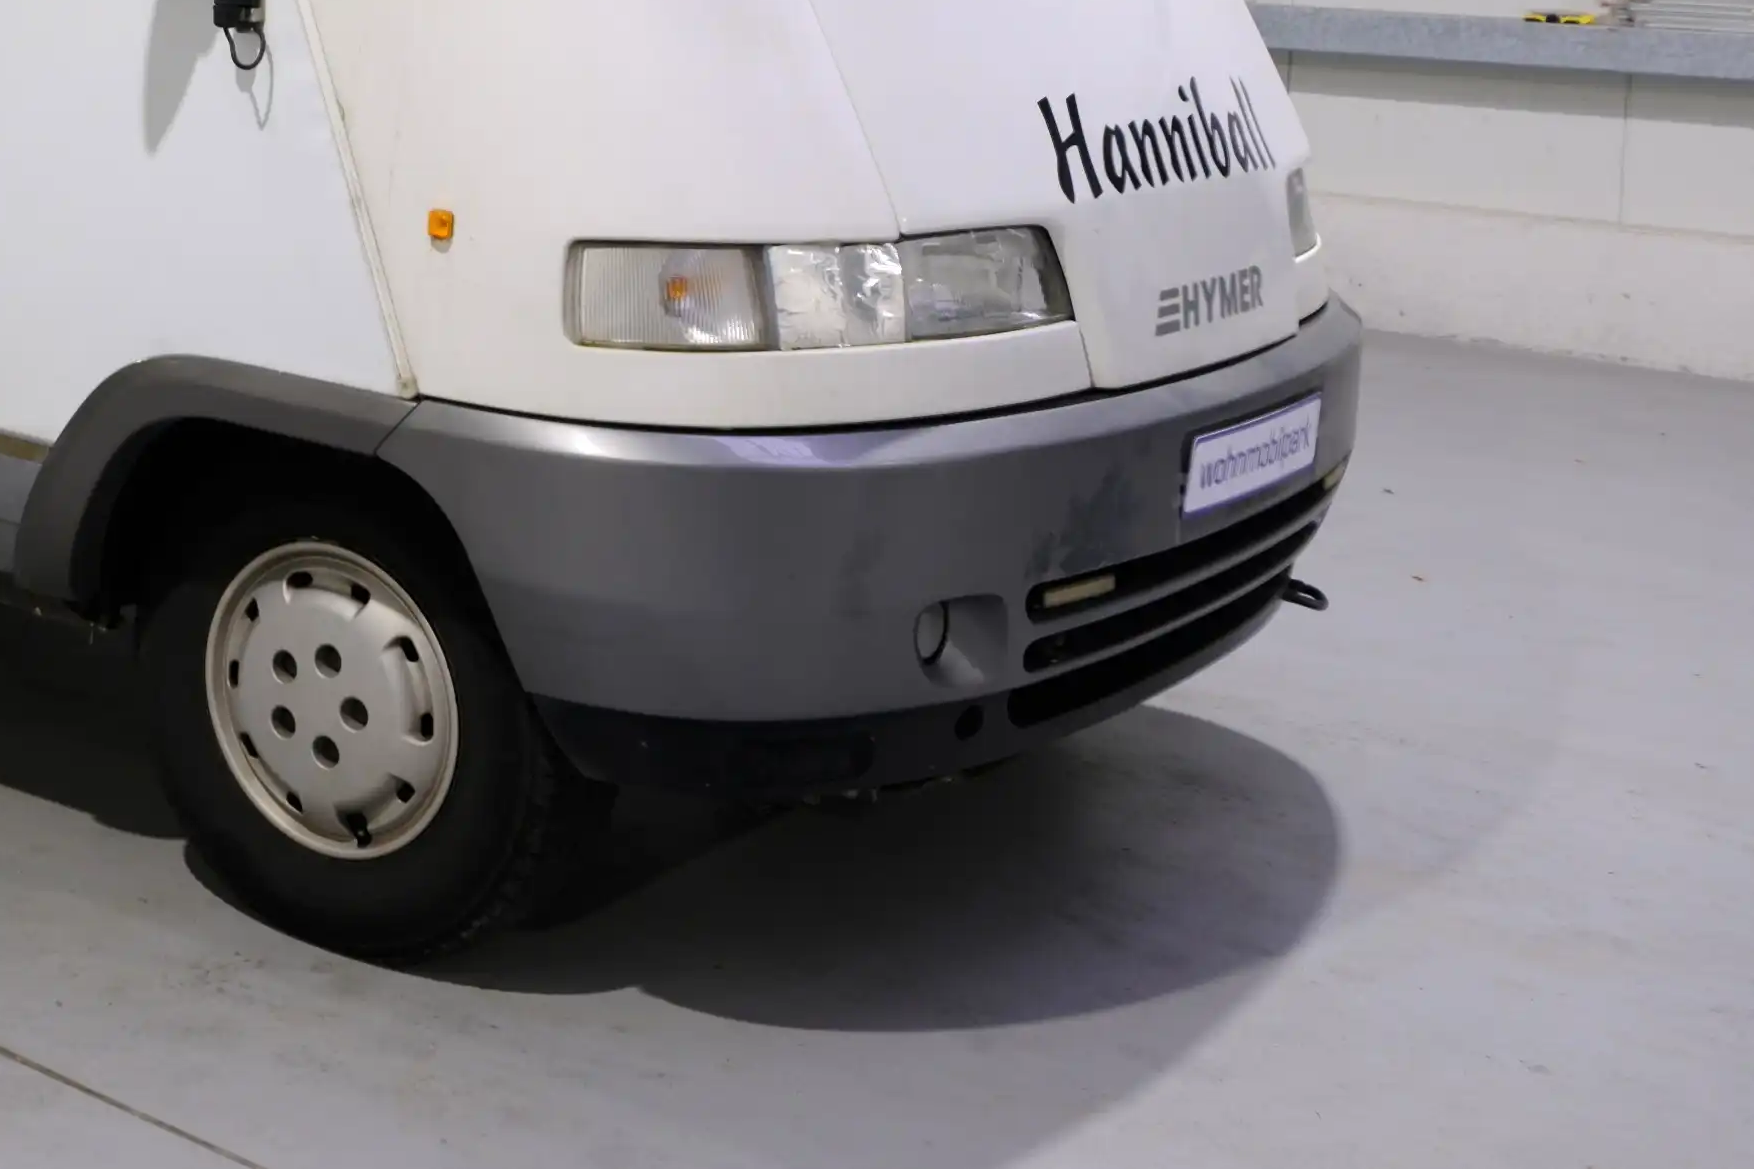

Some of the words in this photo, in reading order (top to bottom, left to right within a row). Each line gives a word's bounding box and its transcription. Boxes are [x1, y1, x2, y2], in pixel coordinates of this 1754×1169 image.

[1037, 76, 1276, 204] Hanniball
[1181, 265, 1264, 330] HYMER
[1199, 413, 1312, 490] wohnmobilpark
